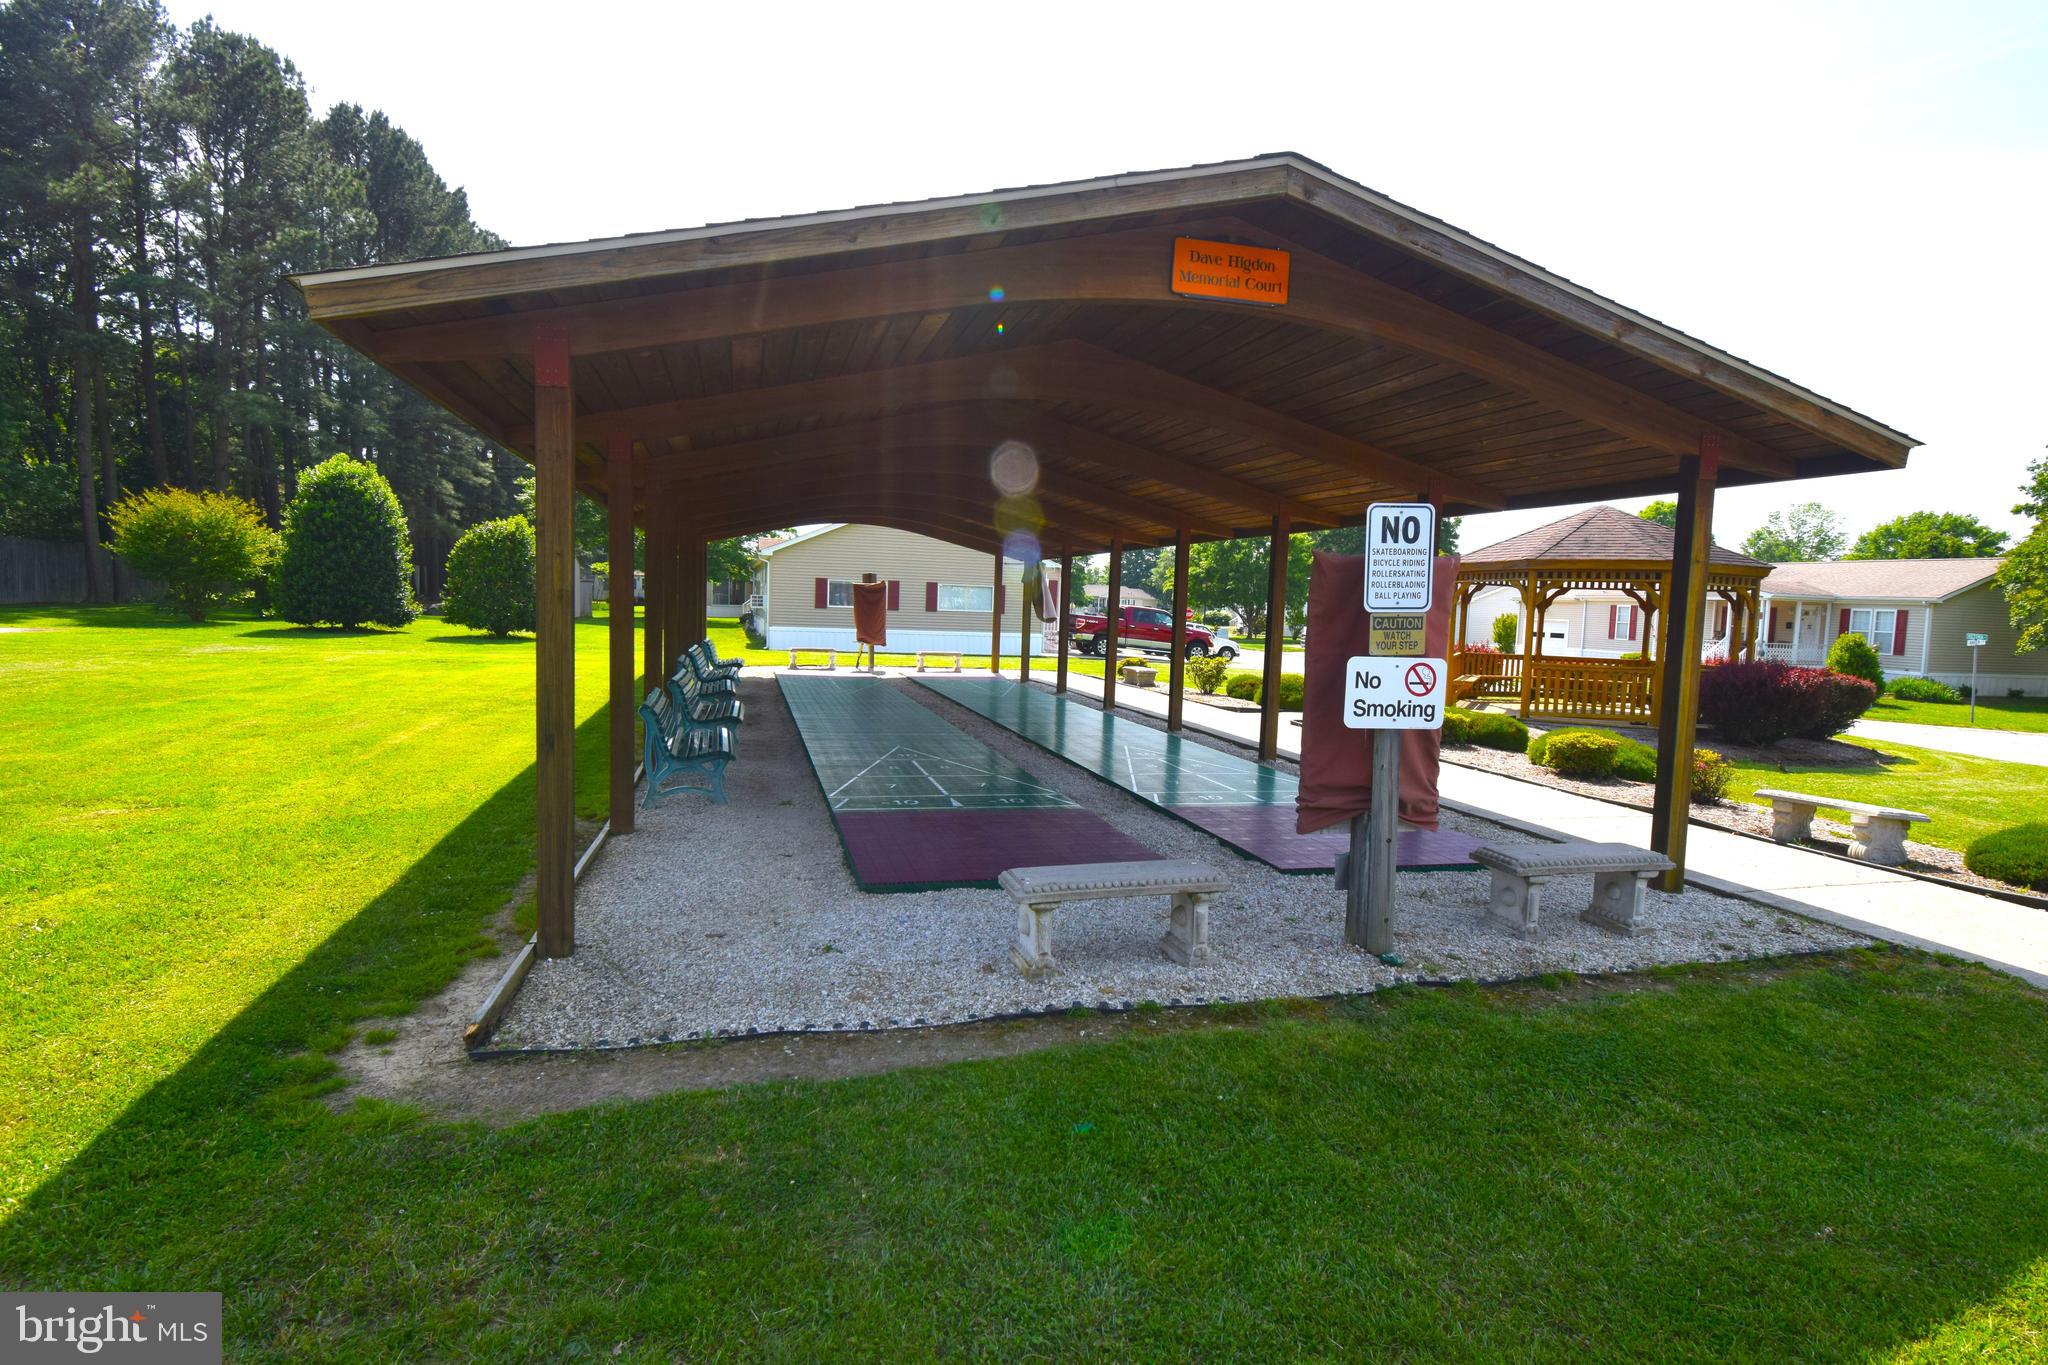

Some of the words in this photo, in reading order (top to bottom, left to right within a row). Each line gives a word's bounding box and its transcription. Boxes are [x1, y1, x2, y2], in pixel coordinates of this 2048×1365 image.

[1189, 250, 1223, 266] Dave
[1227, 255, 1276, 273] Higdon
[1180, 269, 1240, 289] Memorial
[1245, 277, 1283, 293] Court
[1380, 515, 1421, 544] NO
[1372, 548, 1428, 556] SKATEBOARDING
[1373, 559, 1400, 567] BICYCLE
[1402, 559, 1426, 567] RIDING
[1371, 570, 1426, 578] ROLLERSKATING
[1371, 581, 1426, 589] ROLLERBLADING
[1374, 592, 1391, 600] BALL
[1393, 592, 1421, 600] PLAYING
[1374, 617, 1422, 629] CAUTION
[1383, 631, 1412, 640] WATCH
[1376, 641, 1397, 650] YOUR
[1398, 641, 1419, 650] STEP
[1355, 671, 1382, 690] No
[1353, 698, 1436, 722] Smoking
